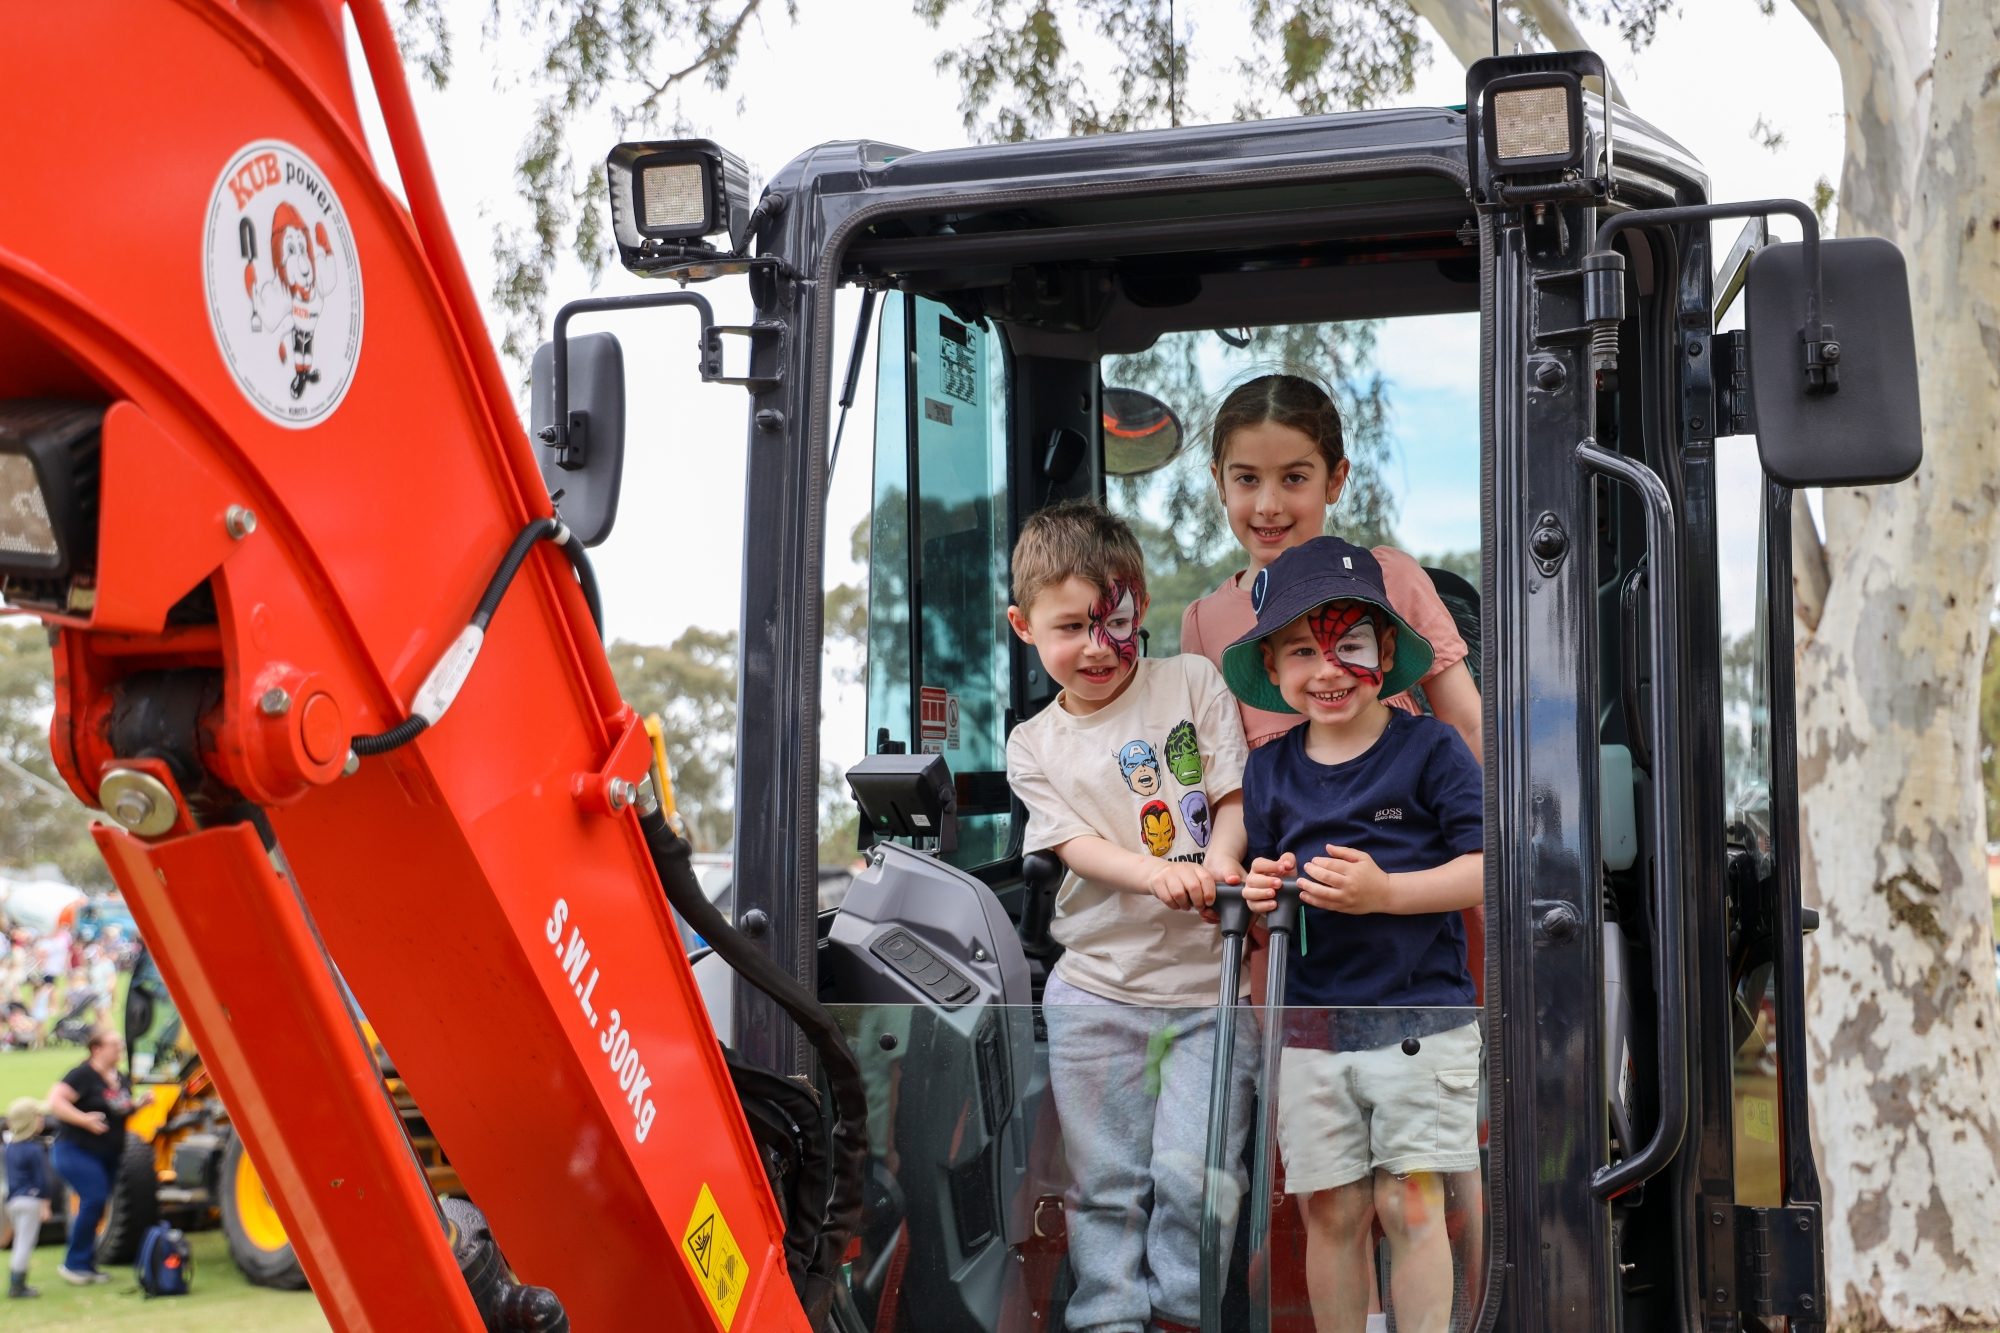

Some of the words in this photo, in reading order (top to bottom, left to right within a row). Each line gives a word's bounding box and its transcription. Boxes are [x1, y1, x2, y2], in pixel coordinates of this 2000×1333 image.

[228, 152, 281, 212] KUB
[286, 161, 332, 216] power
[1375, 807, 1402, 818] BOSS
[546, 898, 600, 1029] S.W.L.
[600, 1009, 657, 1144] 300Kg
